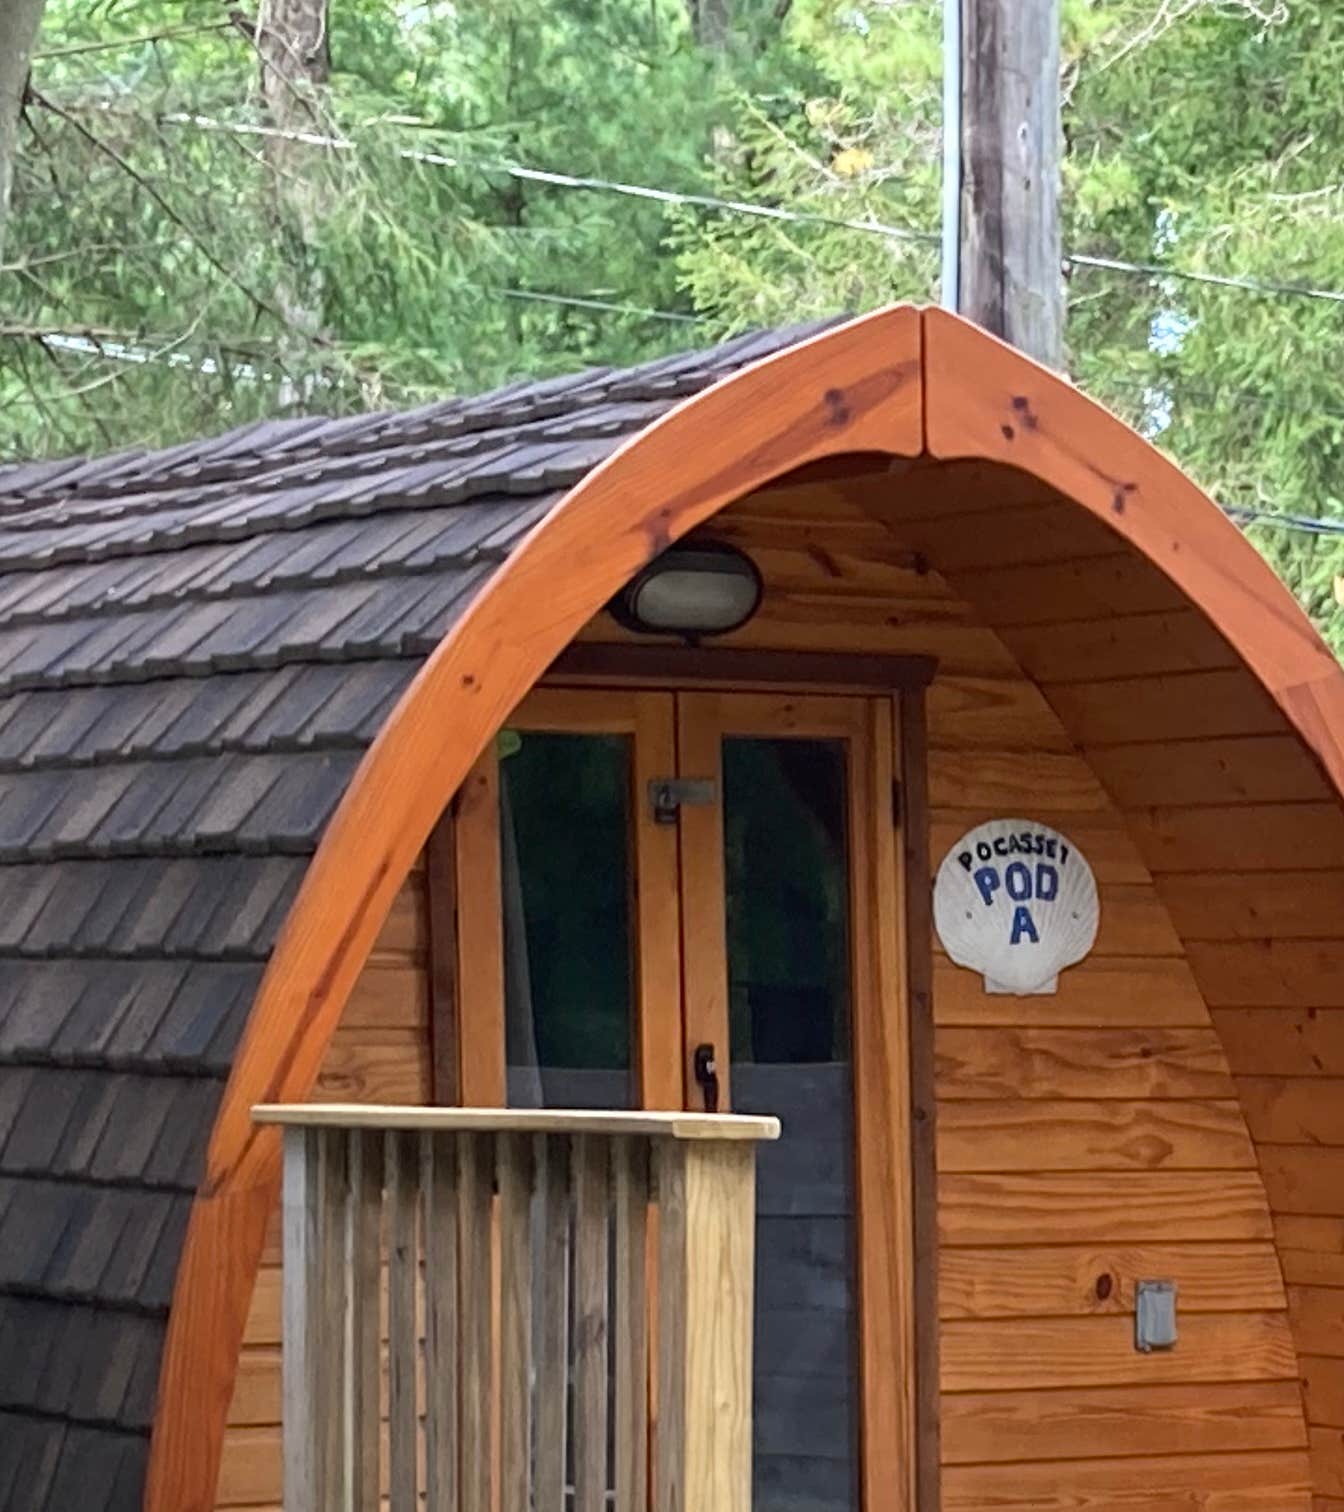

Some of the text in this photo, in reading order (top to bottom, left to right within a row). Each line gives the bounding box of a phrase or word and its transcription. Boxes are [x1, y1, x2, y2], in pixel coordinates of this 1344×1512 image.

[958, 832, 1069, 872] POCASSET
[974, 861, 1059, 906] POD
[1009, 906, 1040, 945] A
